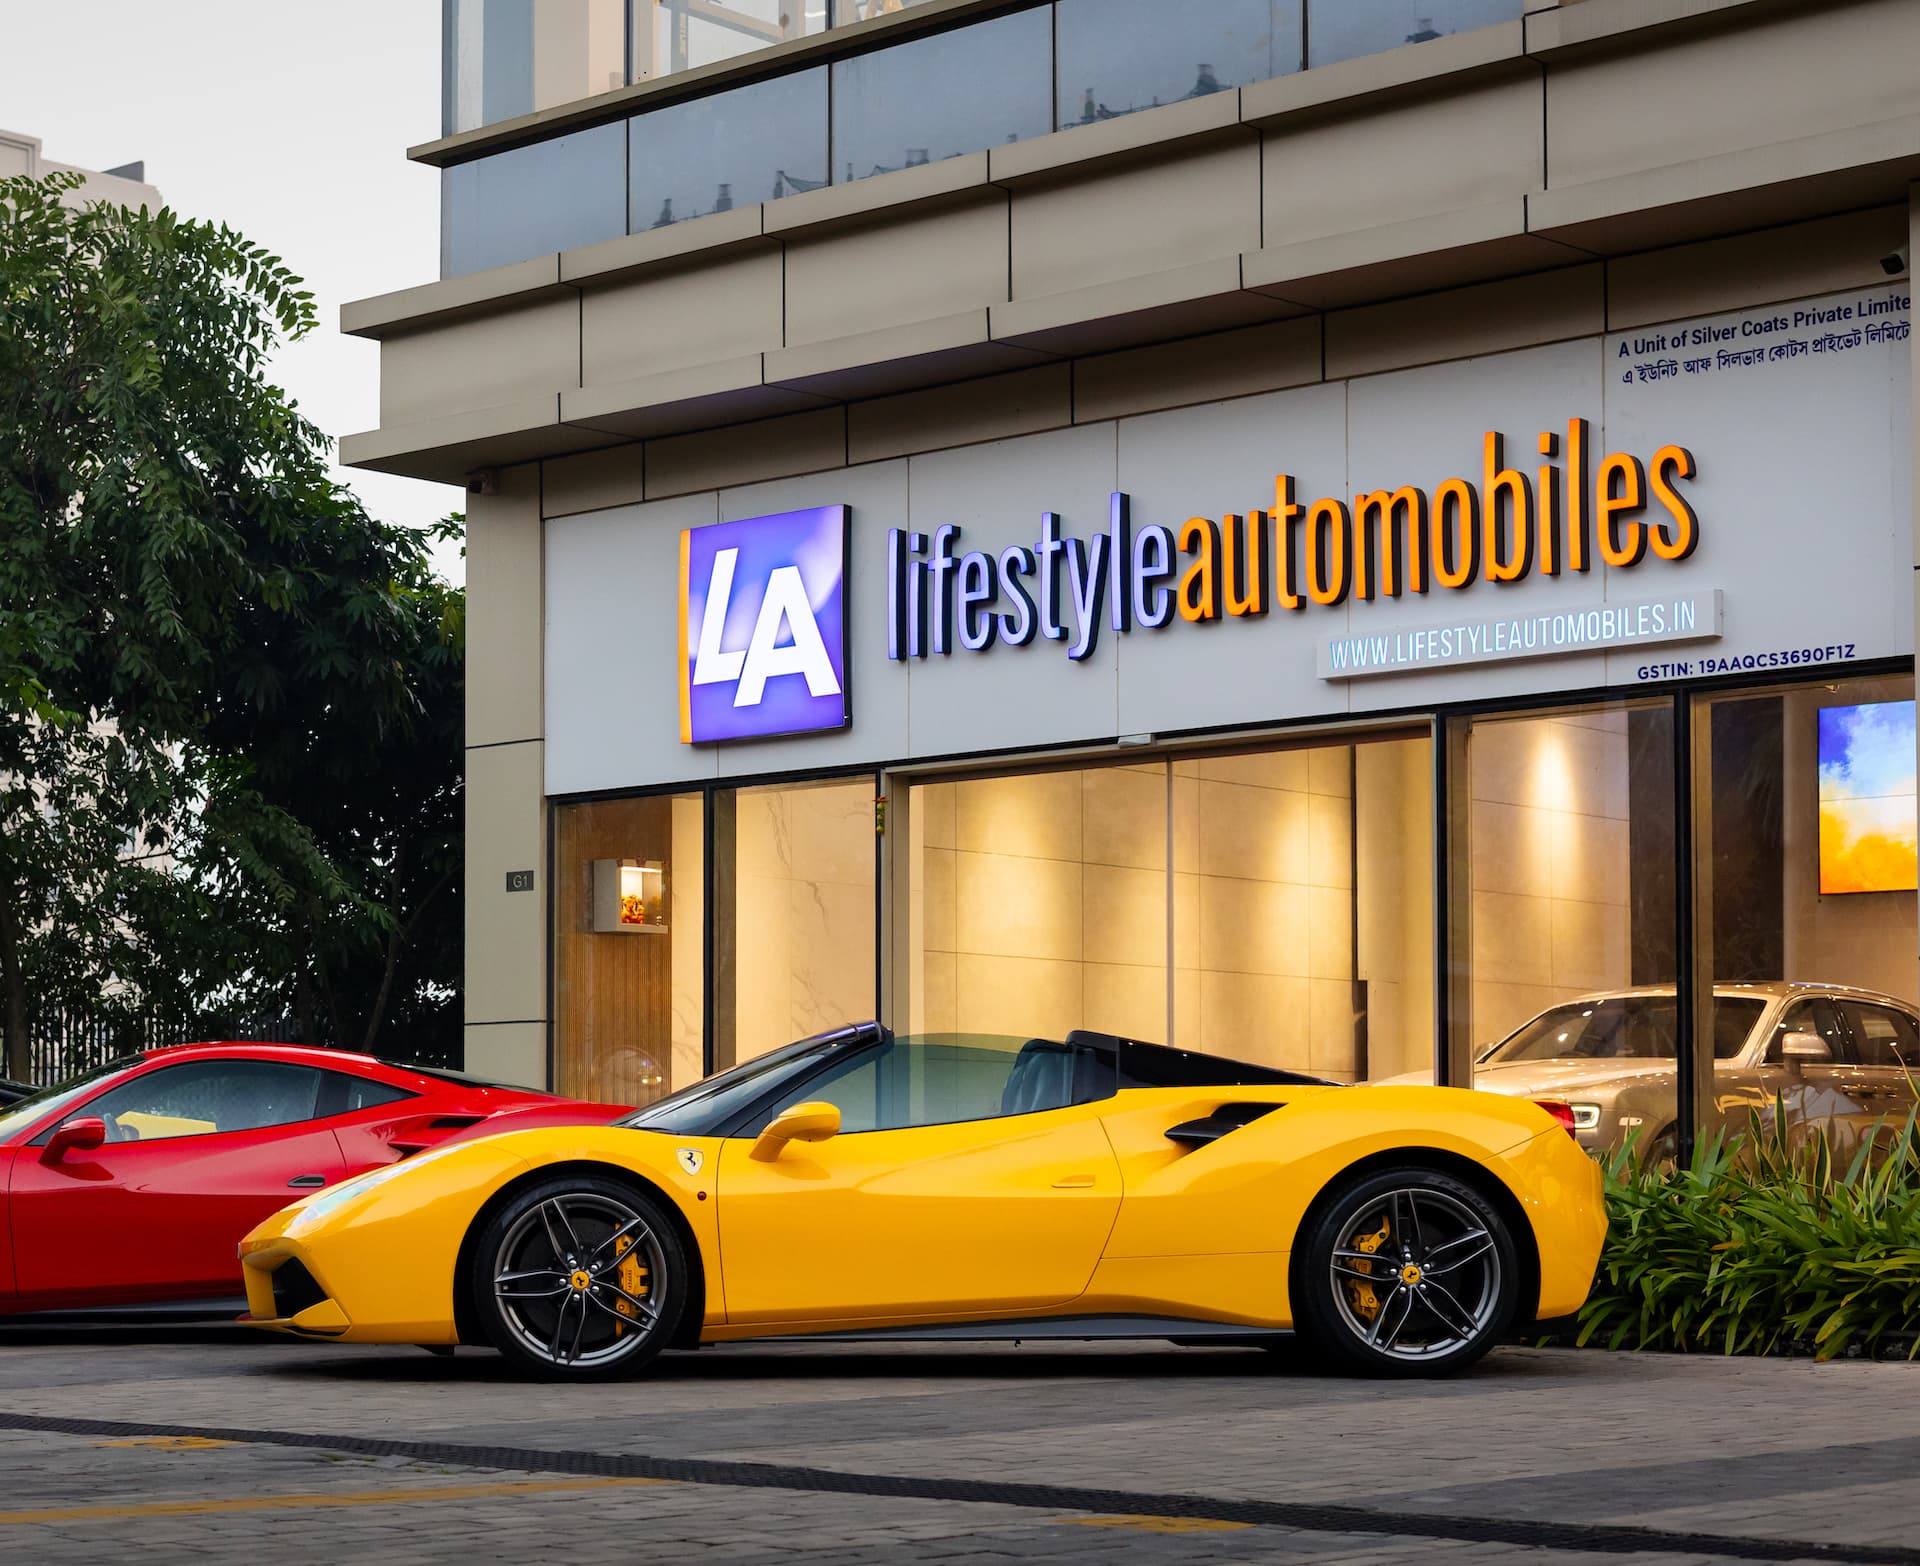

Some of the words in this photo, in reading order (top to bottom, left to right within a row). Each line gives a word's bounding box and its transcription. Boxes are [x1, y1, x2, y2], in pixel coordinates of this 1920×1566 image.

[1618, 341, 1631, 358] A
[1634, 335, 1667, 354] Unit
[1671, 330, 1688, 348] of
[1692, 326, 1738, 345] Silver
[1741, 316, 1789, 337] Coats
[1793, 306, 1853, 328] Private
[1857, 295, 1911, 318] Limite
[1622, 370, 1634, 384] এ
[1634, 358, 1679, 383] ইউনিট
[1716, 349, 1765, 371] সিলভার
[1769, 337, 1809, 361] কোটস
[1811, 328, 1862, 353] প্রাইভেট
[1864, 320, 1911, 345] লিমিটে
[692, 547, 842, 708] LA
[1330, 600, 1696, 669] WWW.LIFESTYLEAUTOMOBILES.IN
[1637, 661, 1694, 680] GSTIN:
[1699, 644, 1856, 674] 19AAQCS3690F1Z
[512, 874, 528, 888] G1
